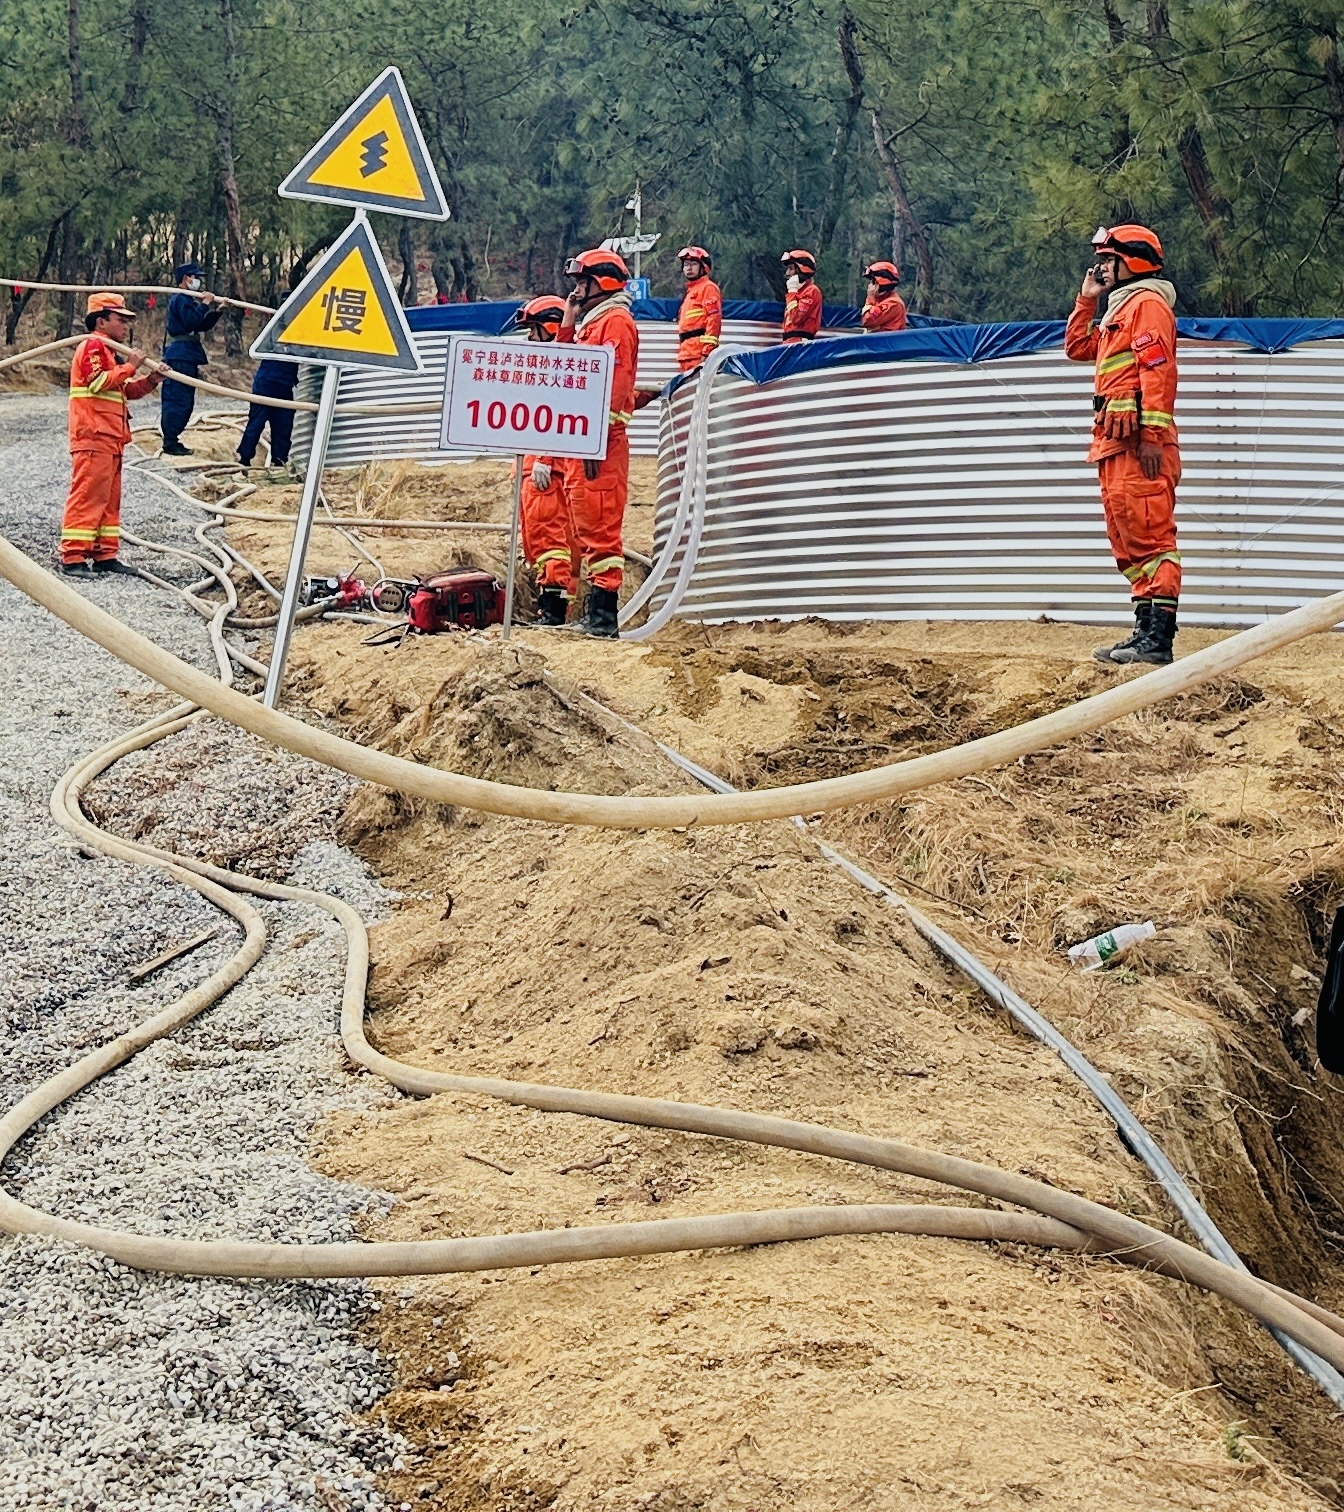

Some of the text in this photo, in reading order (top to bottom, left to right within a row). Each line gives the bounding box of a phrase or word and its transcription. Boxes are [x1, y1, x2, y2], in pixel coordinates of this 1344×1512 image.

[321, 286, 367, 336] 慢
[461, 349, 602, 374] 冕宁县泸沽镇孙水关社区
[472, 367, 588, 390] 森林草原防灭火通道
[466, 399, 590, 437] 1000m
